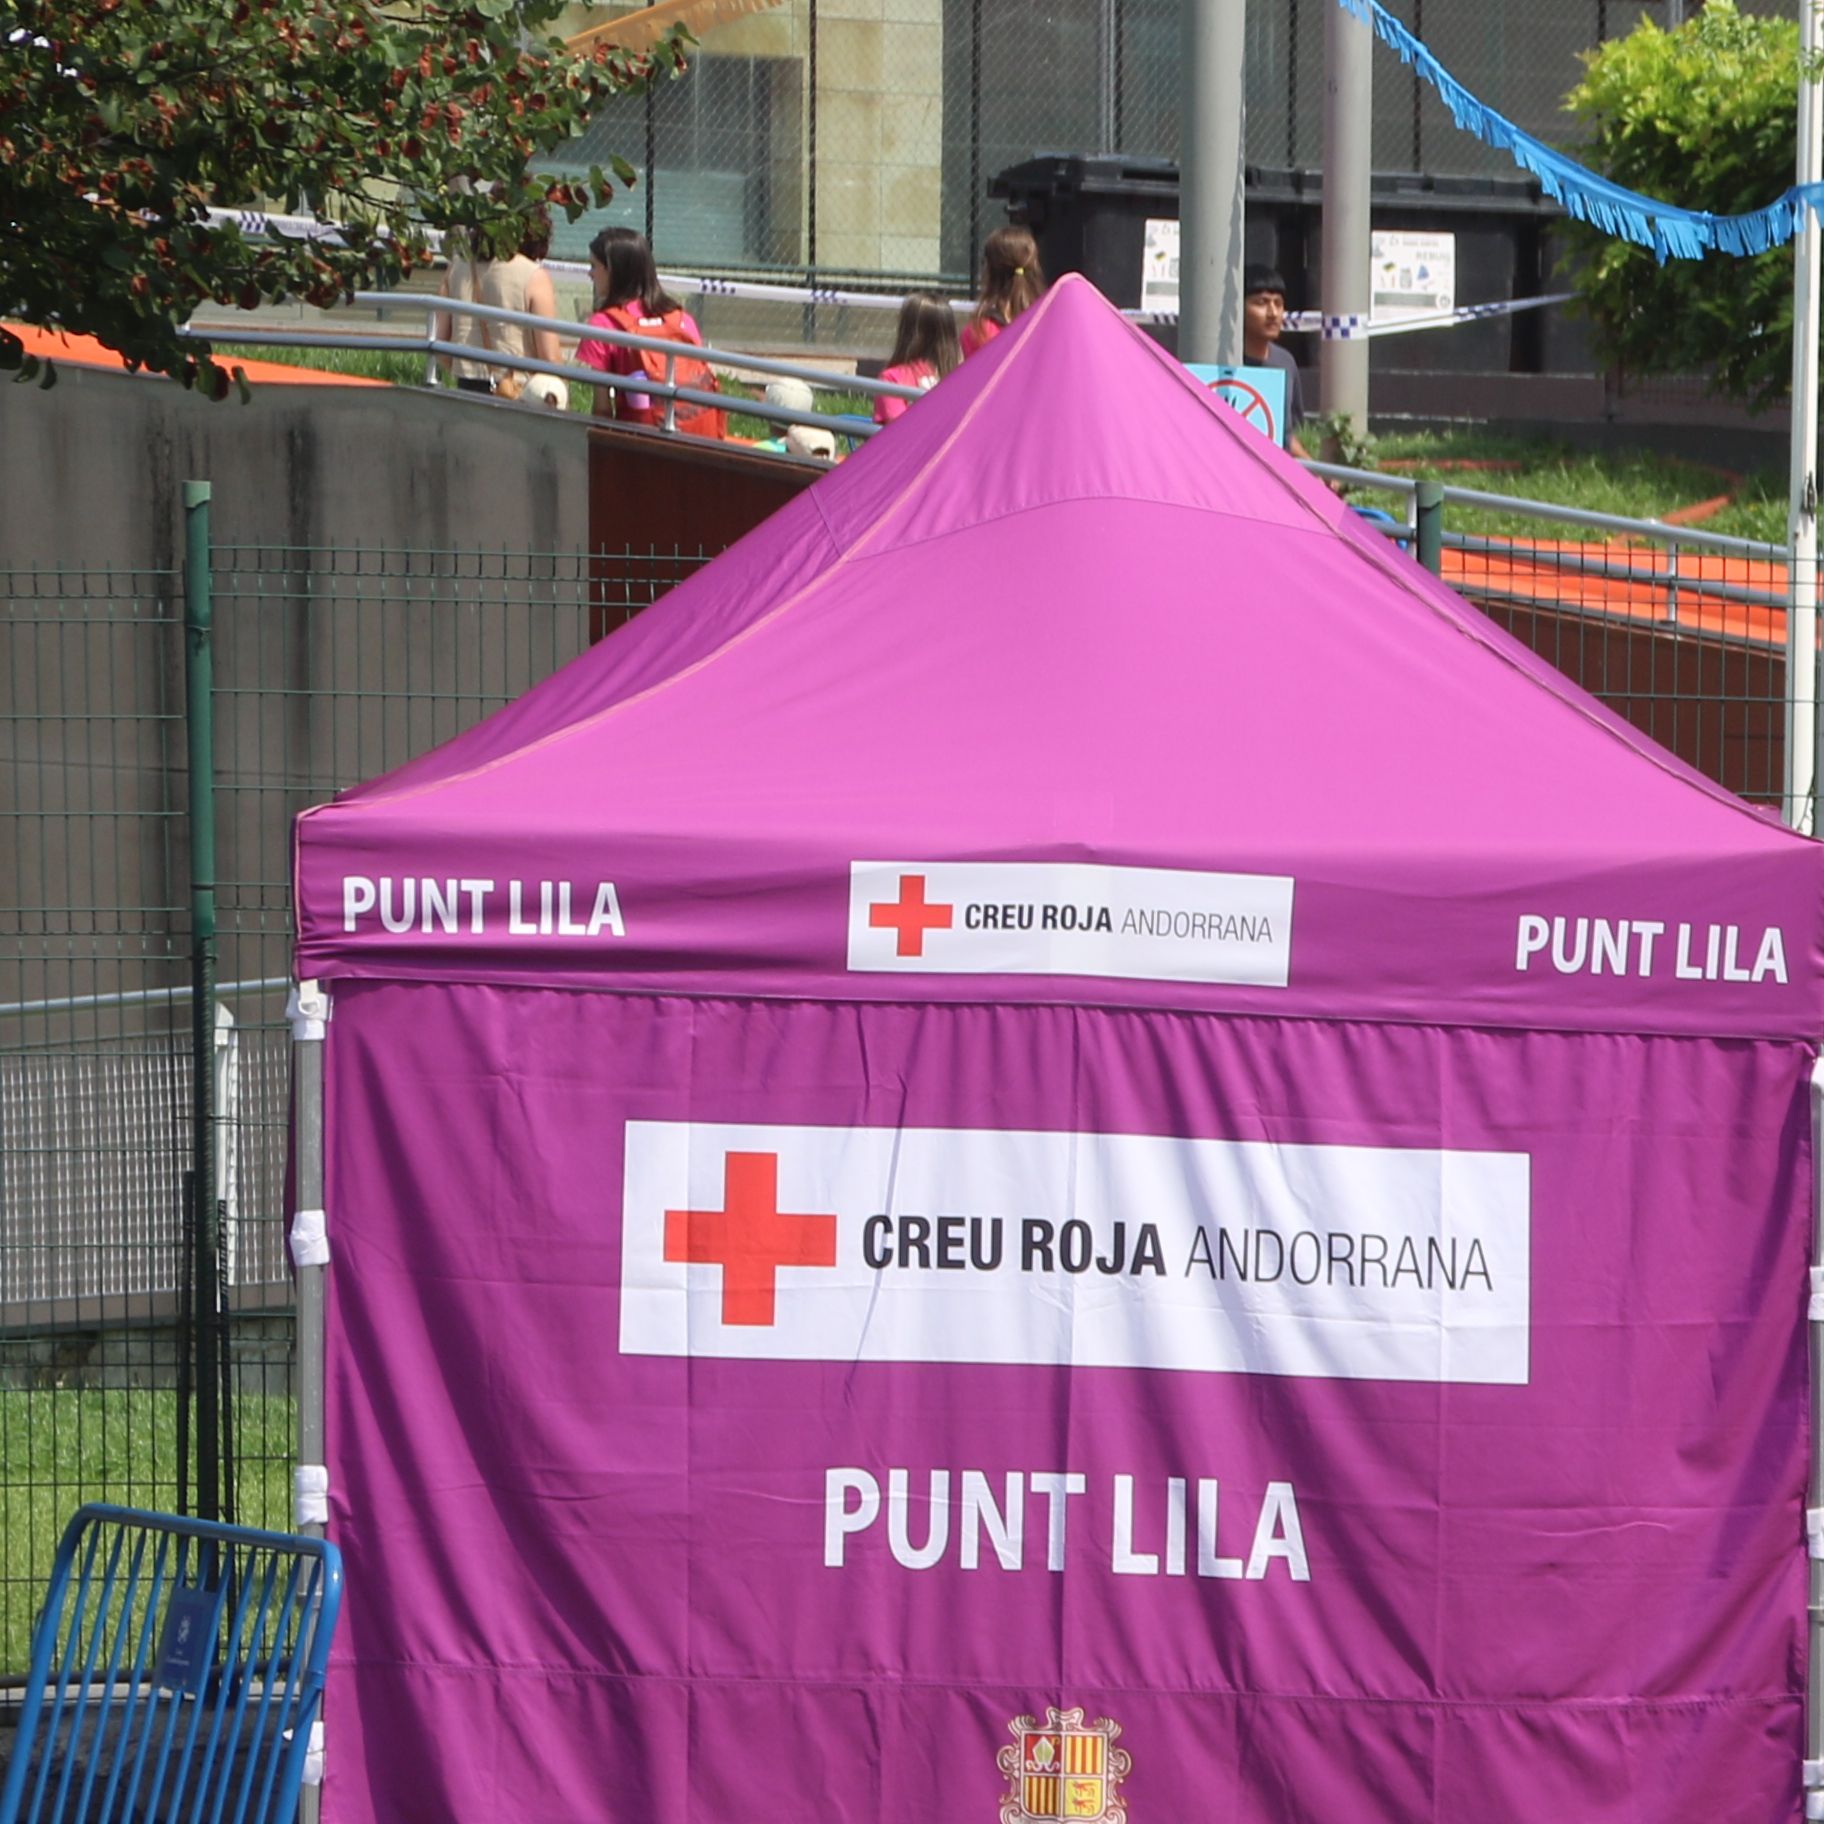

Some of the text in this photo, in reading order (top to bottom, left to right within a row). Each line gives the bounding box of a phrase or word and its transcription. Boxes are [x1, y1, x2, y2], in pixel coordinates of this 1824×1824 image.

[343, 876, 626, 937] PUNT LILA
[964, 902, 1274, 945] CREU ROJA ANDORRANA
[1515, 913, 1790, 984] PUNT LILA
[861, 1213, 1494, 1292] CREU ROJA ANDORRANA
[823, 1466, 1311, 1582] PUNT LILA
